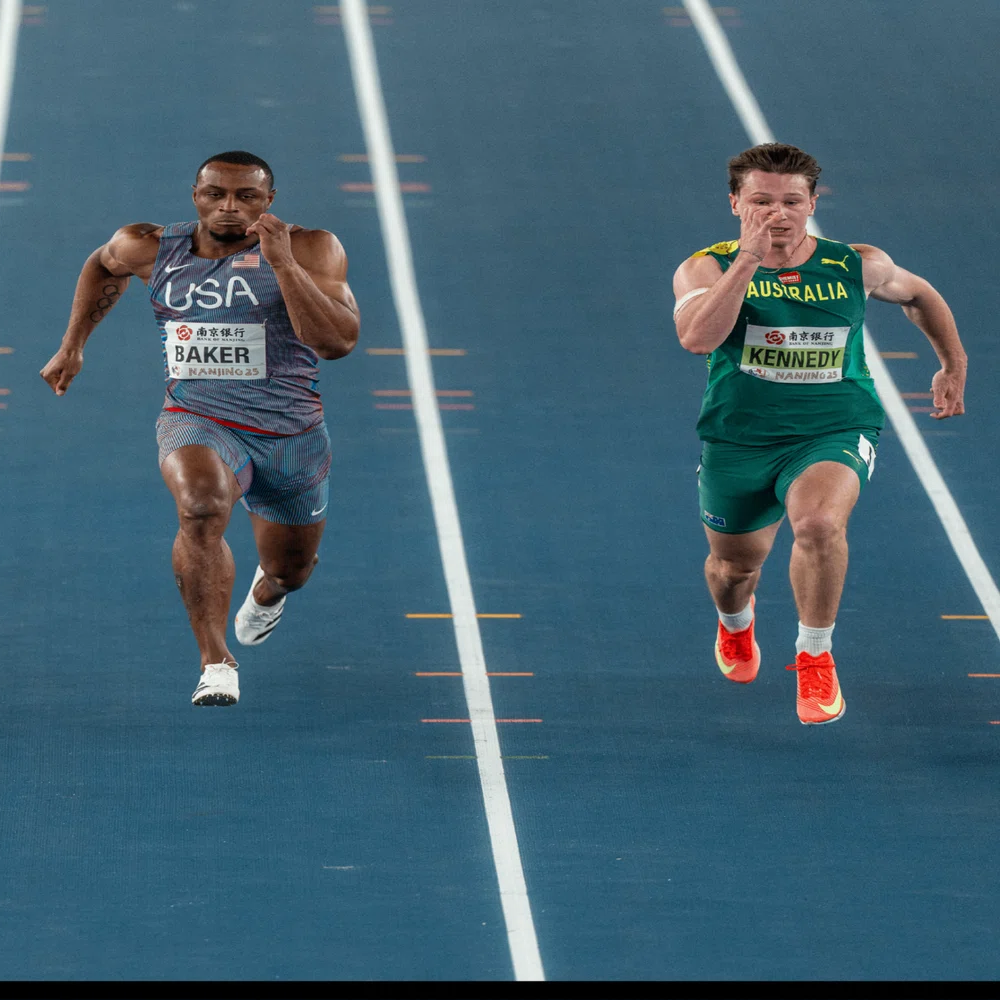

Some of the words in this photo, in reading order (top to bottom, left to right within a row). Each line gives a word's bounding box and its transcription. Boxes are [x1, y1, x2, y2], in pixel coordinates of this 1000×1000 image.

[165, 276, 259, 311] USA
[747, 280, 848, 302] AUSTRALIA
[175, 345, 250, 364] BAKER
[749, 347, 841, 368] KENNEDY
[188, 367, 244, 377] NANJING
[244, 368, 260, 376] 25
[775, 371, 825, 381] NANJING
[826, 371, 838, 379] 25
